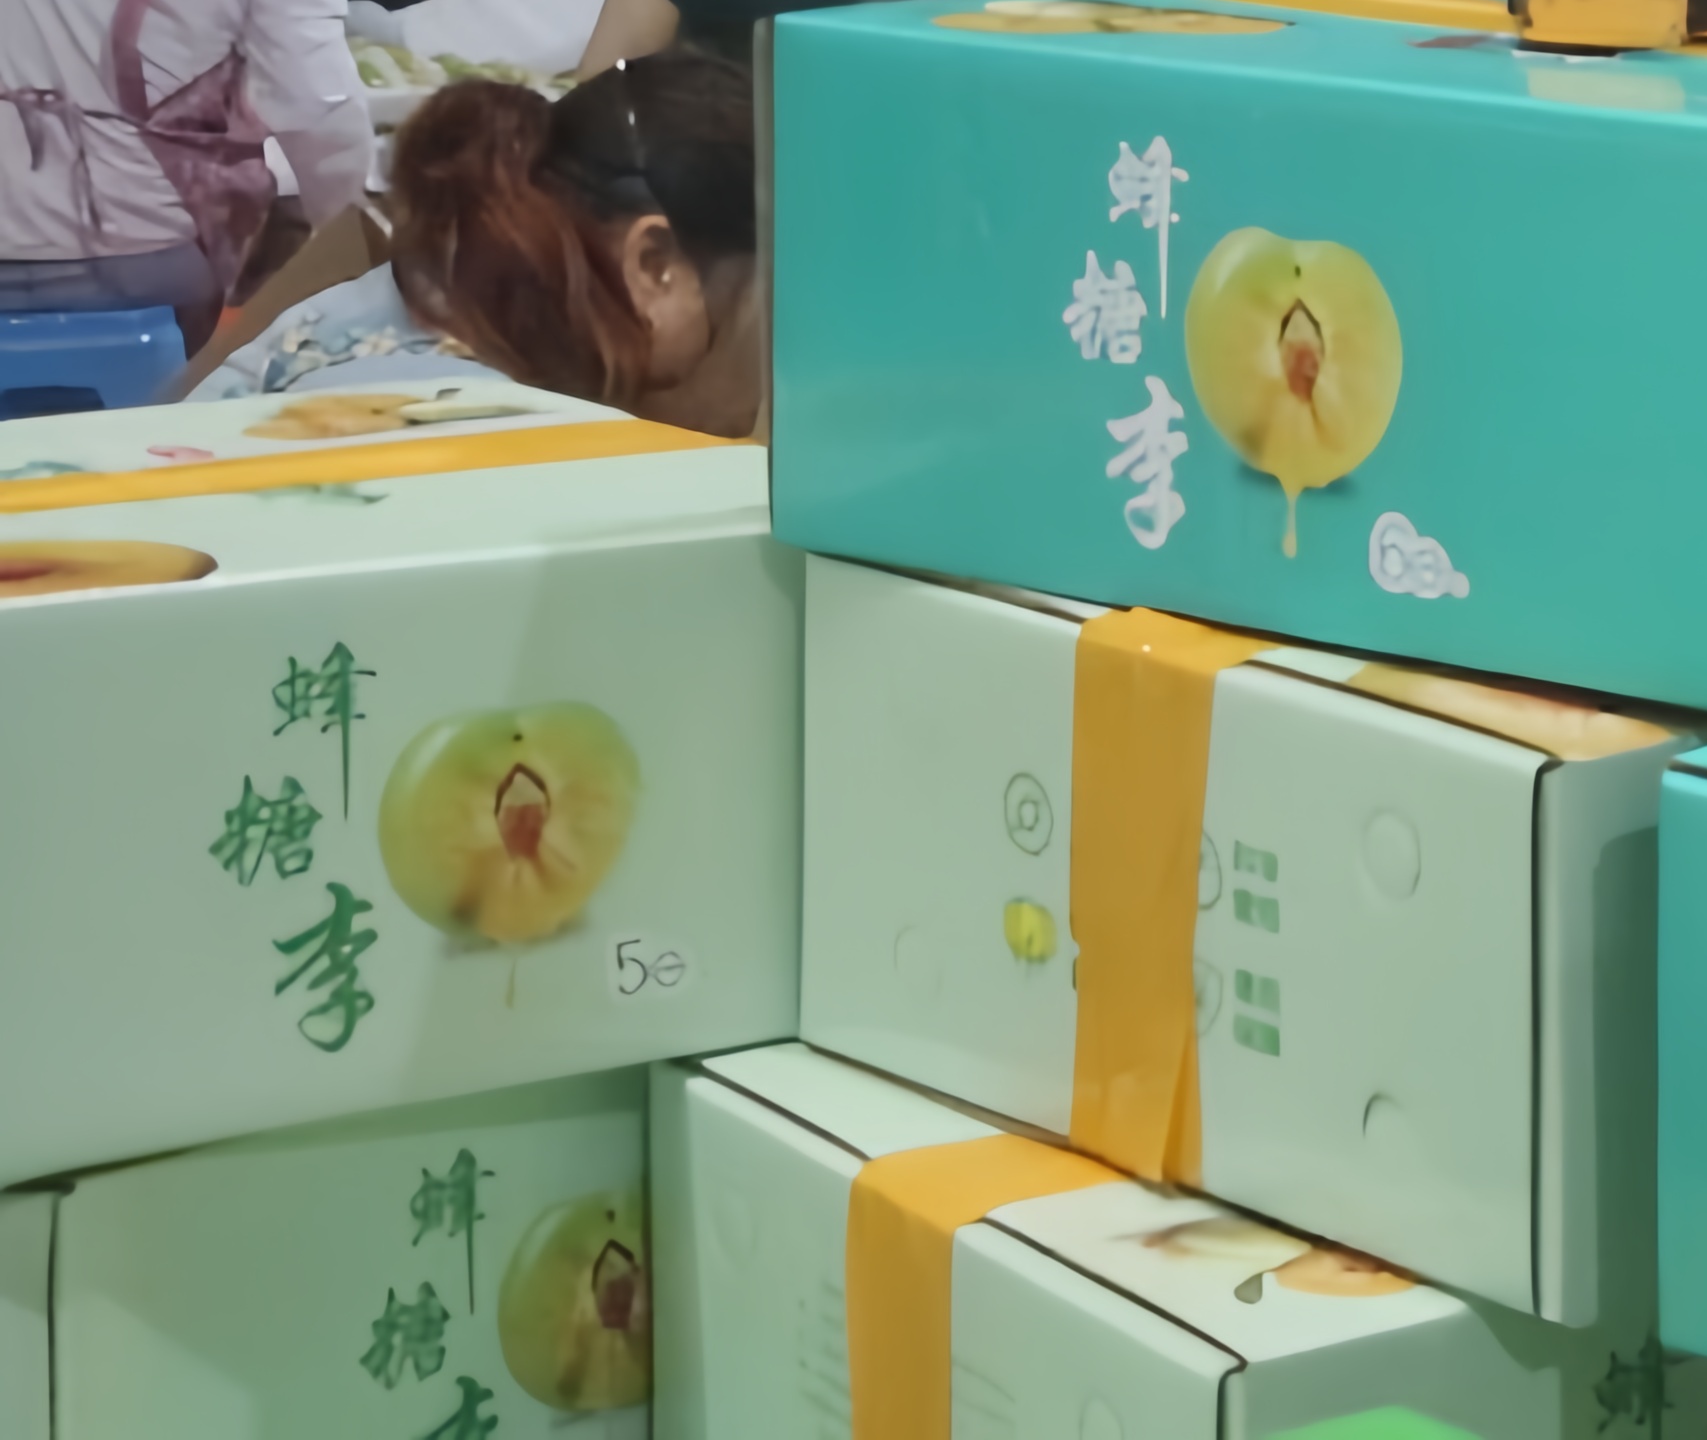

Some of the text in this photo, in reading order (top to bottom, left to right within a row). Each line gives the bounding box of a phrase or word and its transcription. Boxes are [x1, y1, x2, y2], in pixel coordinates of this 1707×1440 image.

[1063, 135, 1190, 550] 蜂糖李
[209, 642, 378, 1053] 蜂糖李
